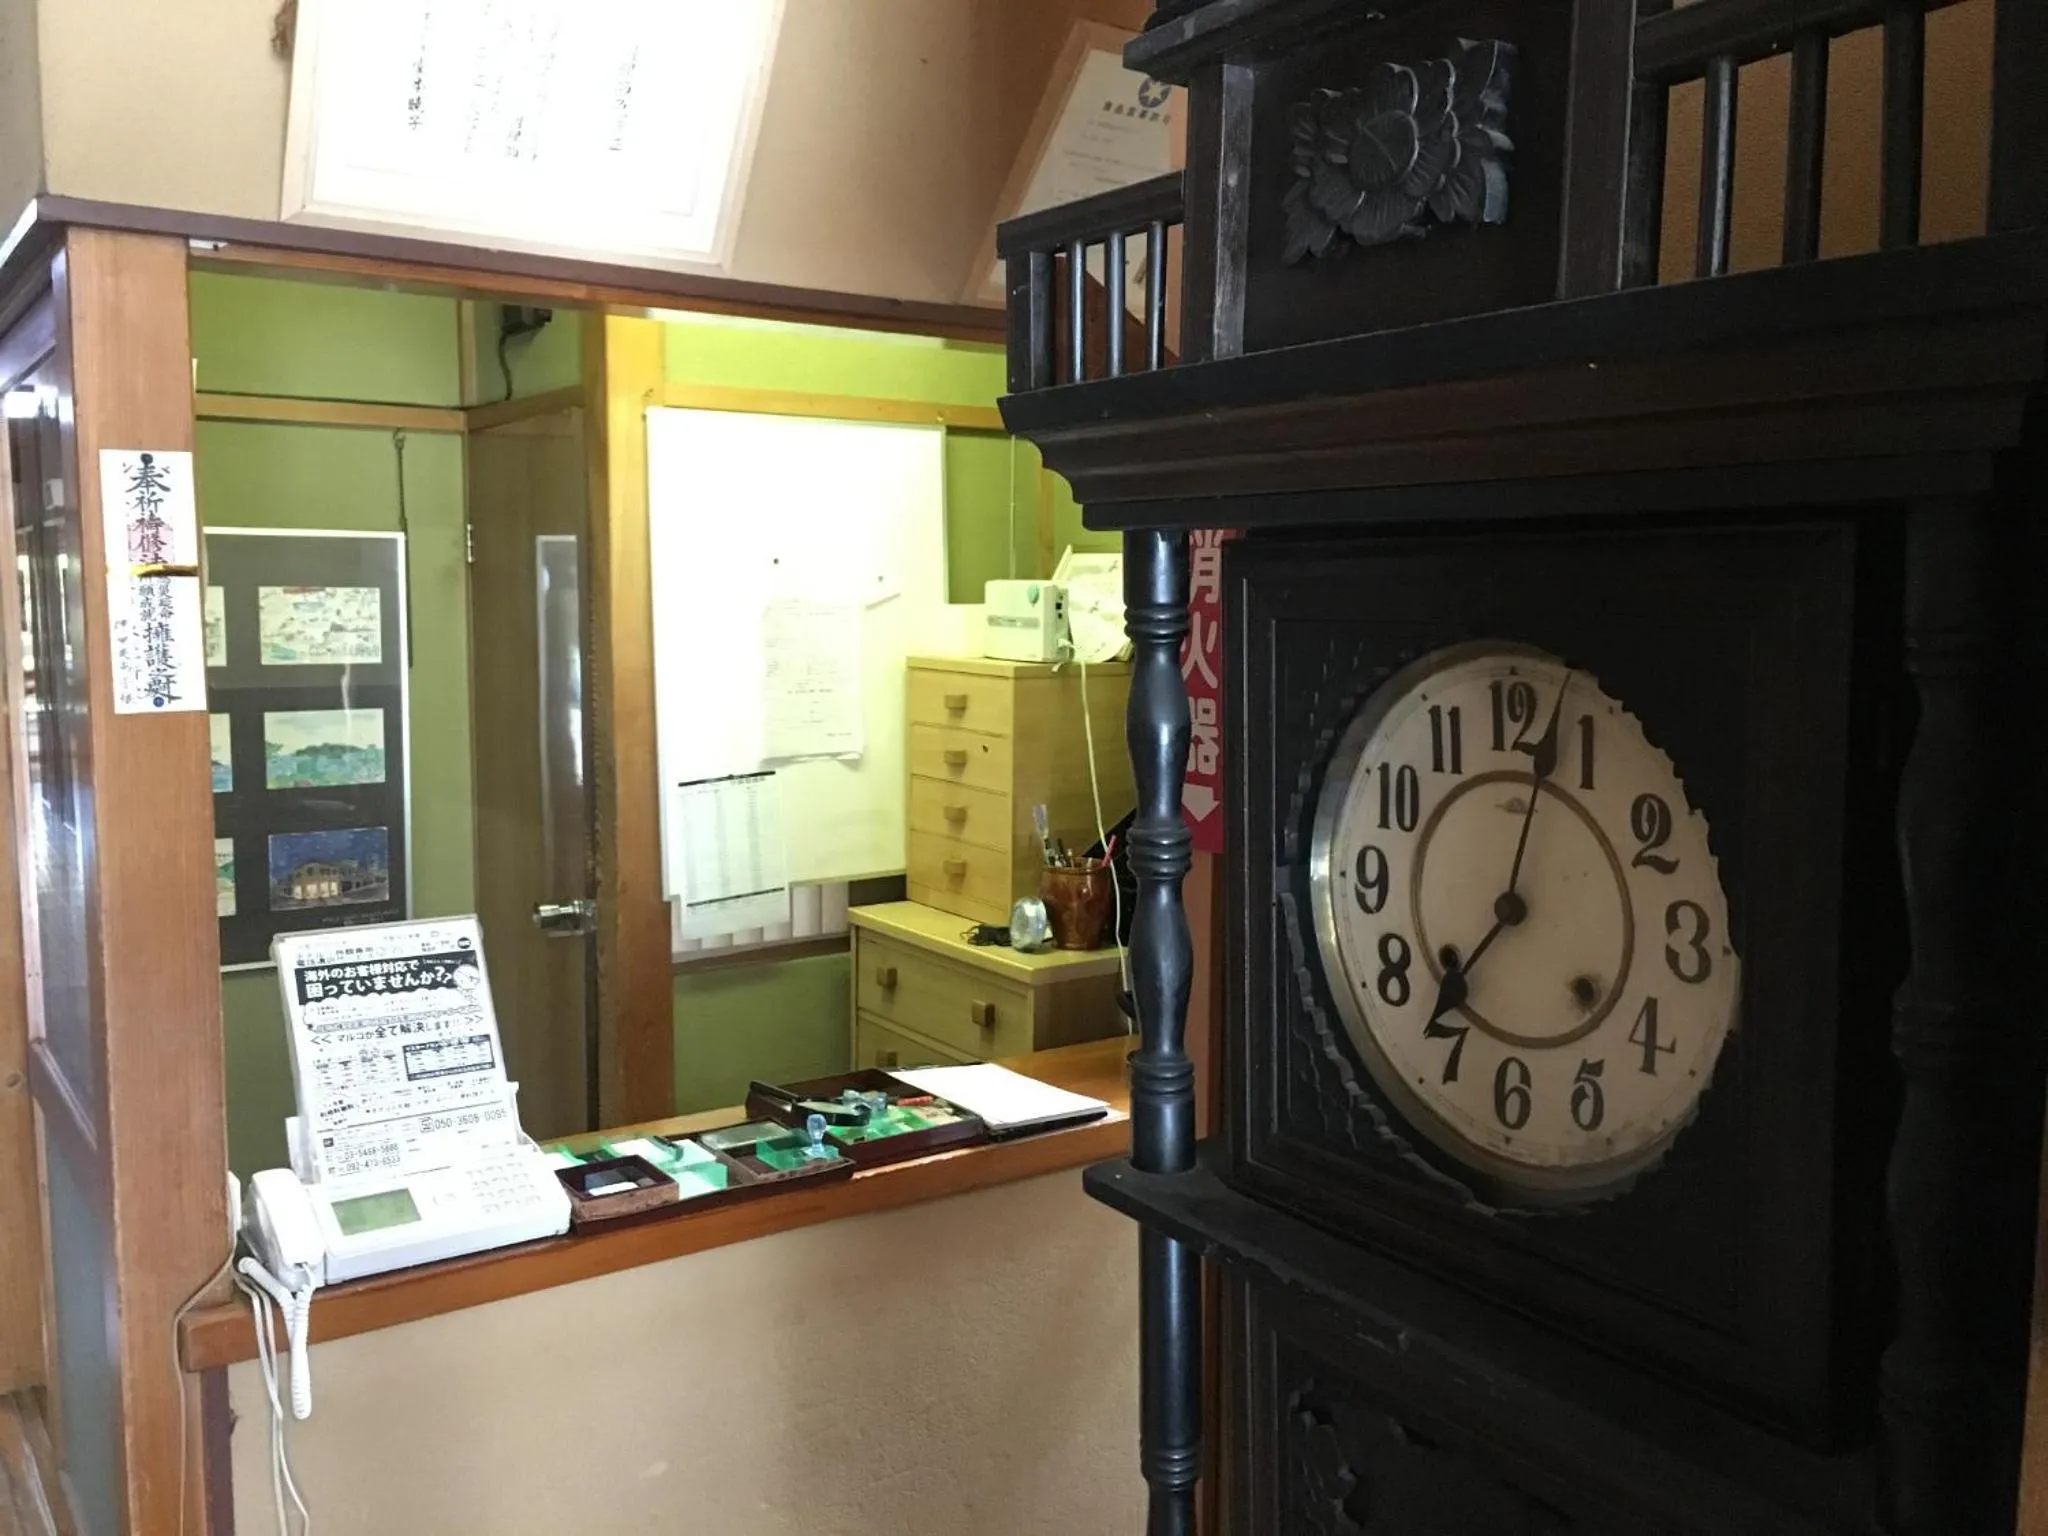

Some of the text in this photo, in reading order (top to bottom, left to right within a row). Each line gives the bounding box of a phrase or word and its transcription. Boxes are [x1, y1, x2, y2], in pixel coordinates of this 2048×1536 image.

[1428, 704, 1463, 775] 11
[1489, 680, 1540, 756] 12
[1577, 714, 1595, 790] 1
[1377, 763, 1420, 832] 10
[1631, 793, 1680, 875] 2
[1354, 845, 1390, 915] 9
[1377, 933, 1412, 1007] 8
[1664, 900, 1712, 984] 3
[1424, 1015, 1470, 1085] 7
[1628, 996, 1677, 1076] 4
[1494, 1057, 1532, 1130] 6
[1570, 1058, 1605, 1131] 5
